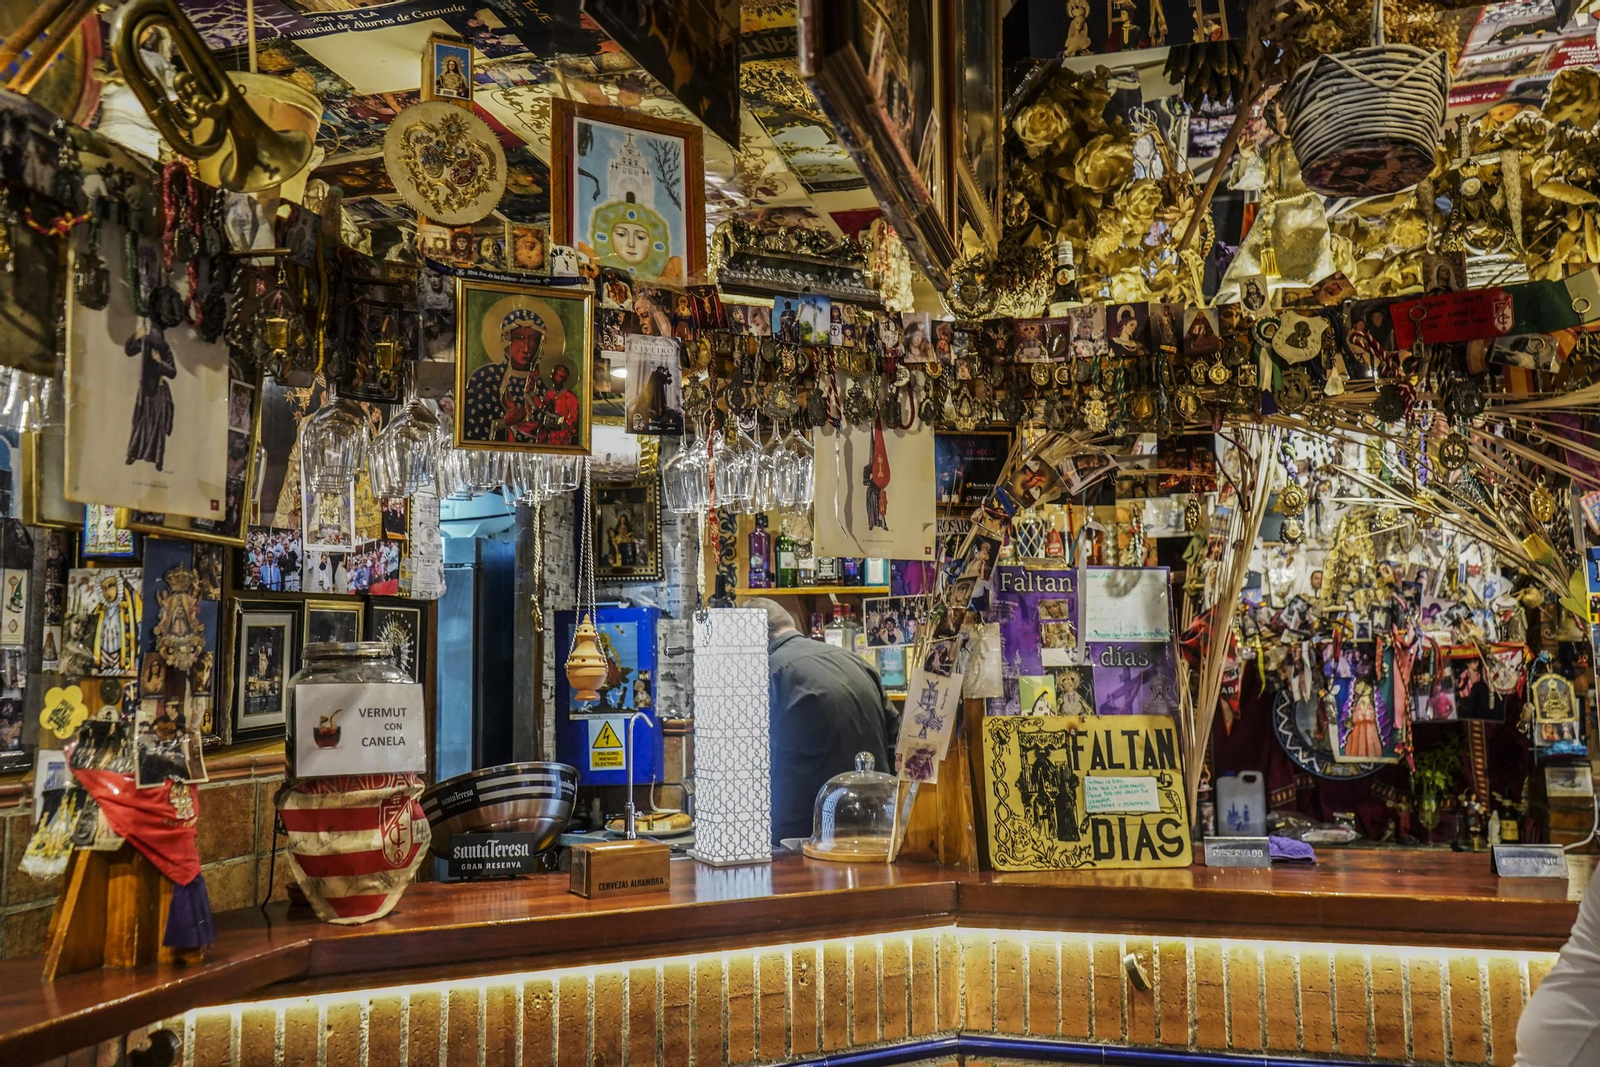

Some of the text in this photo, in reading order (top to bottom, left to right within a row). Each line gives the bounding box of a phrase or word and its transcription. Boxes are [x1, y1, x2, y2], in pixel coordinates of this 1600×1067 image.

[353, 16, 395, 30] Ahorros
[398, 12, 411, 23] de
[411, 4, 466, 20] Granada
[500, 274, 518, 282] Dolores
[633, 345, 675, 355] VIVEIRO
[1000, 572, 1074, 593] Faltan
[1101, 645, 1150, 668] días
[358, 707, 408, 719] VERMUT
[384, 722, 403, 731] CON
[361, 735, 406, 748] CANELA
[1069, 728, 1177, 771] FALTAN
[1091, 816, 1185, 862] DIAS
[453, 839, 530, 859] santaTeresa
[1212, 848, 1264, 858] RESERVADO
[461, 861, 522, 871] GRAN RESERVA
[598, 876, 664, 892] CERVEZAS ALHAMBRA
